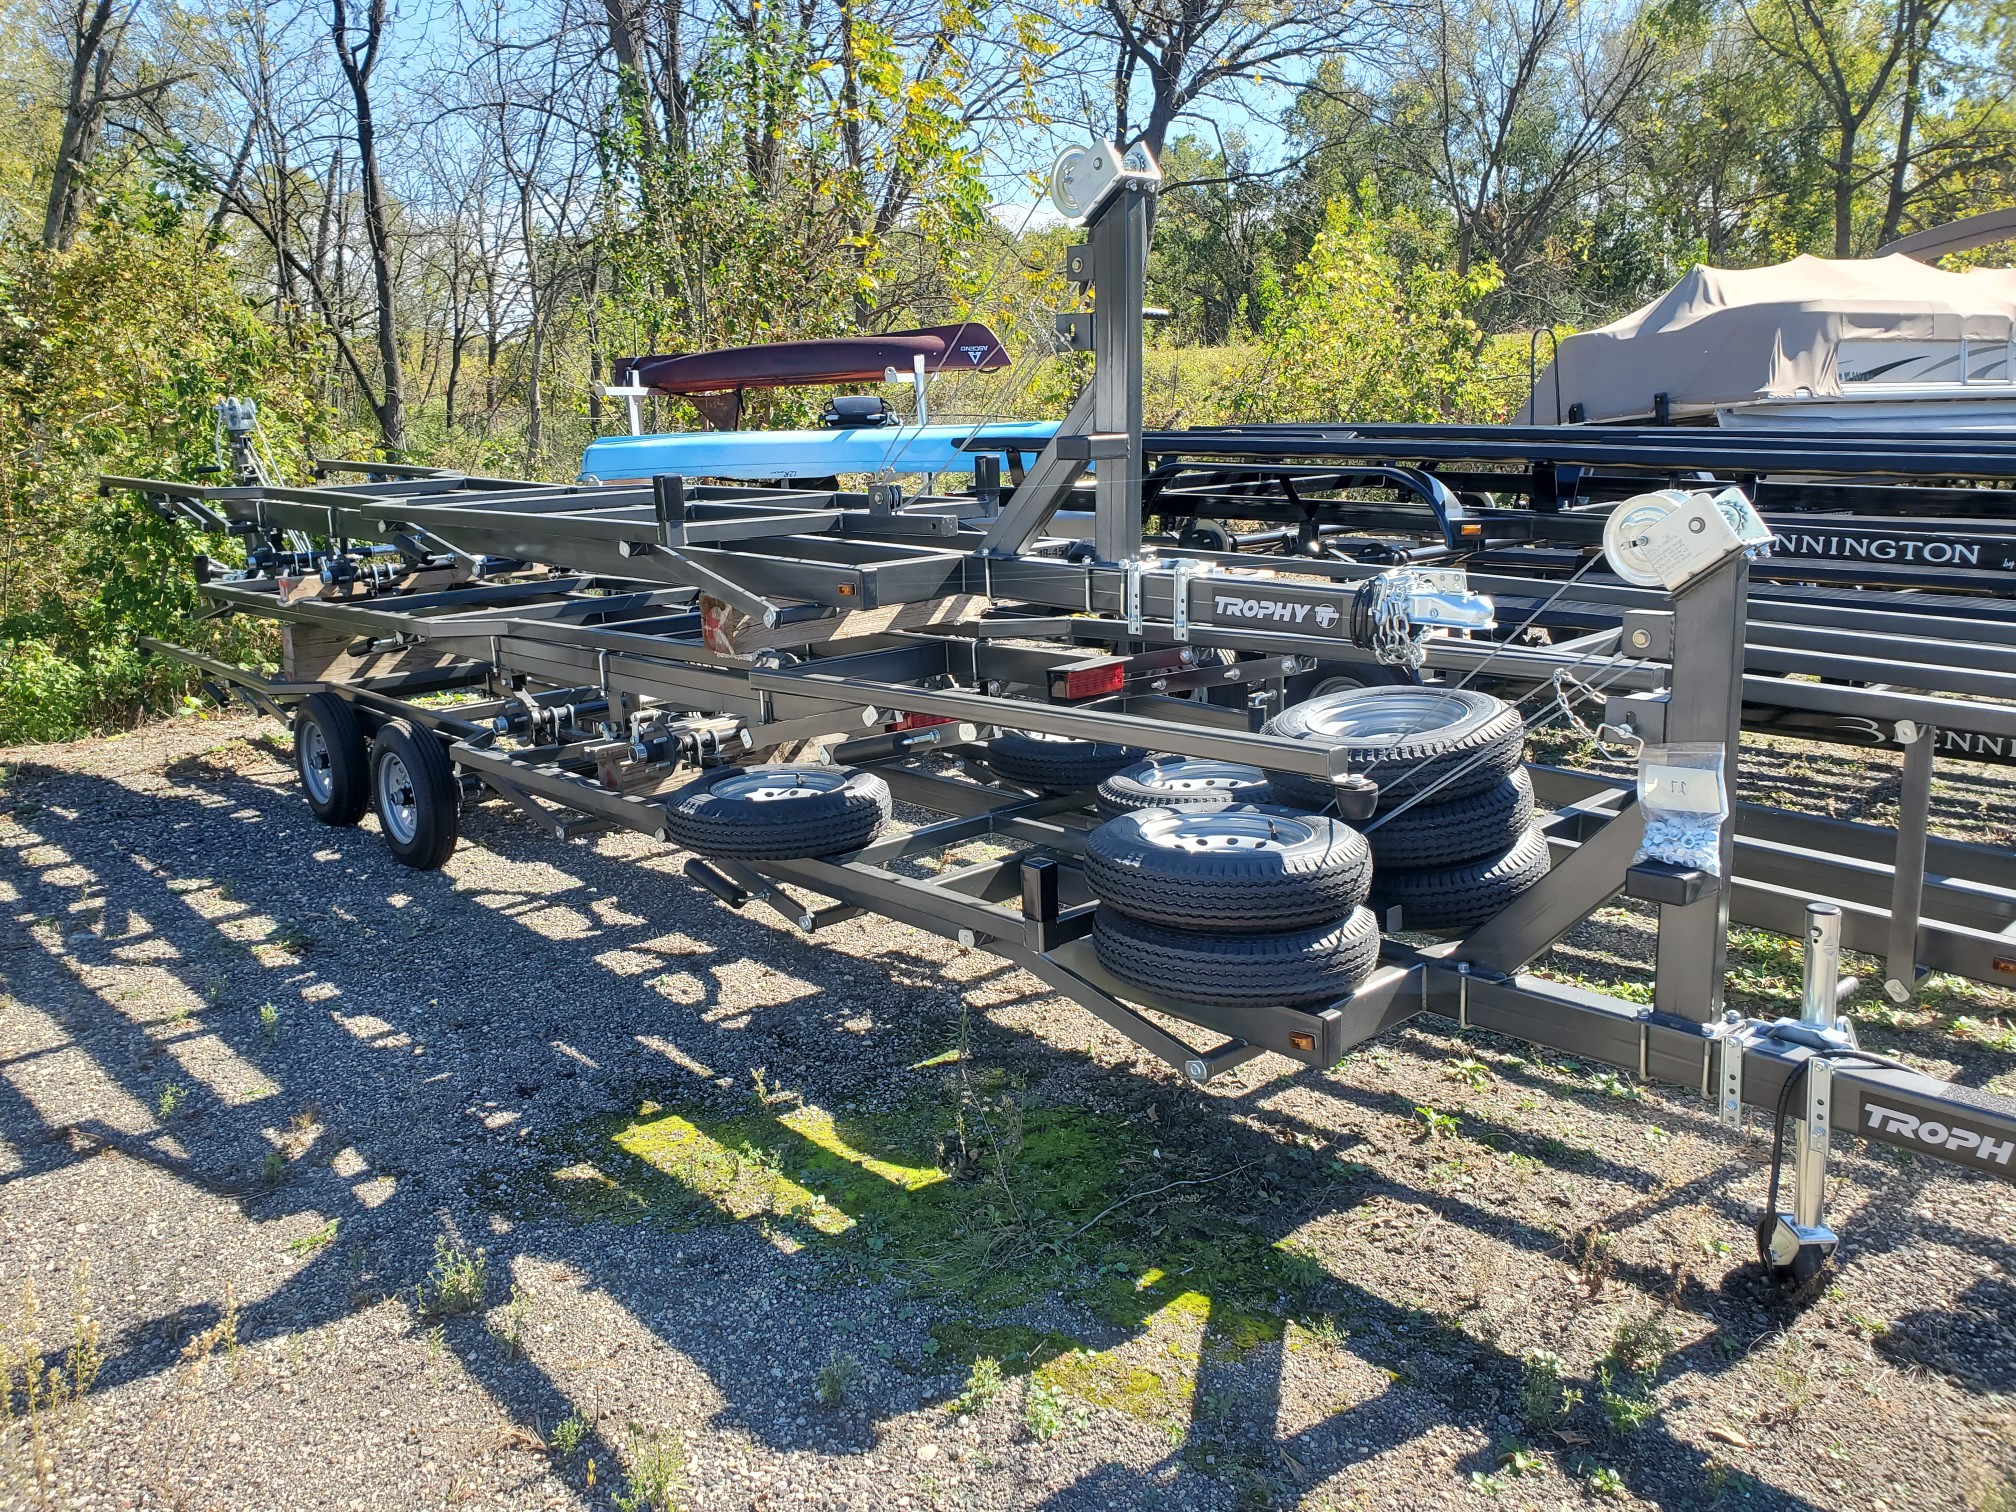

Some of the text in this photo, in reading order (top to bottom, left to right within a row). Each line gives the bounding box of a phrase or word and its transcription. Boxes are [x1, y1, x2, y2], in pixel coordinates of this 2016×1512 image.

[1038, 546, 1065, 557] 18-45
[1772, 533, 1981, 564] NNINGTON
[1214, 595, 1312, 623] TROPHY
[1864, 1102, 2016, 1165] TROPH
